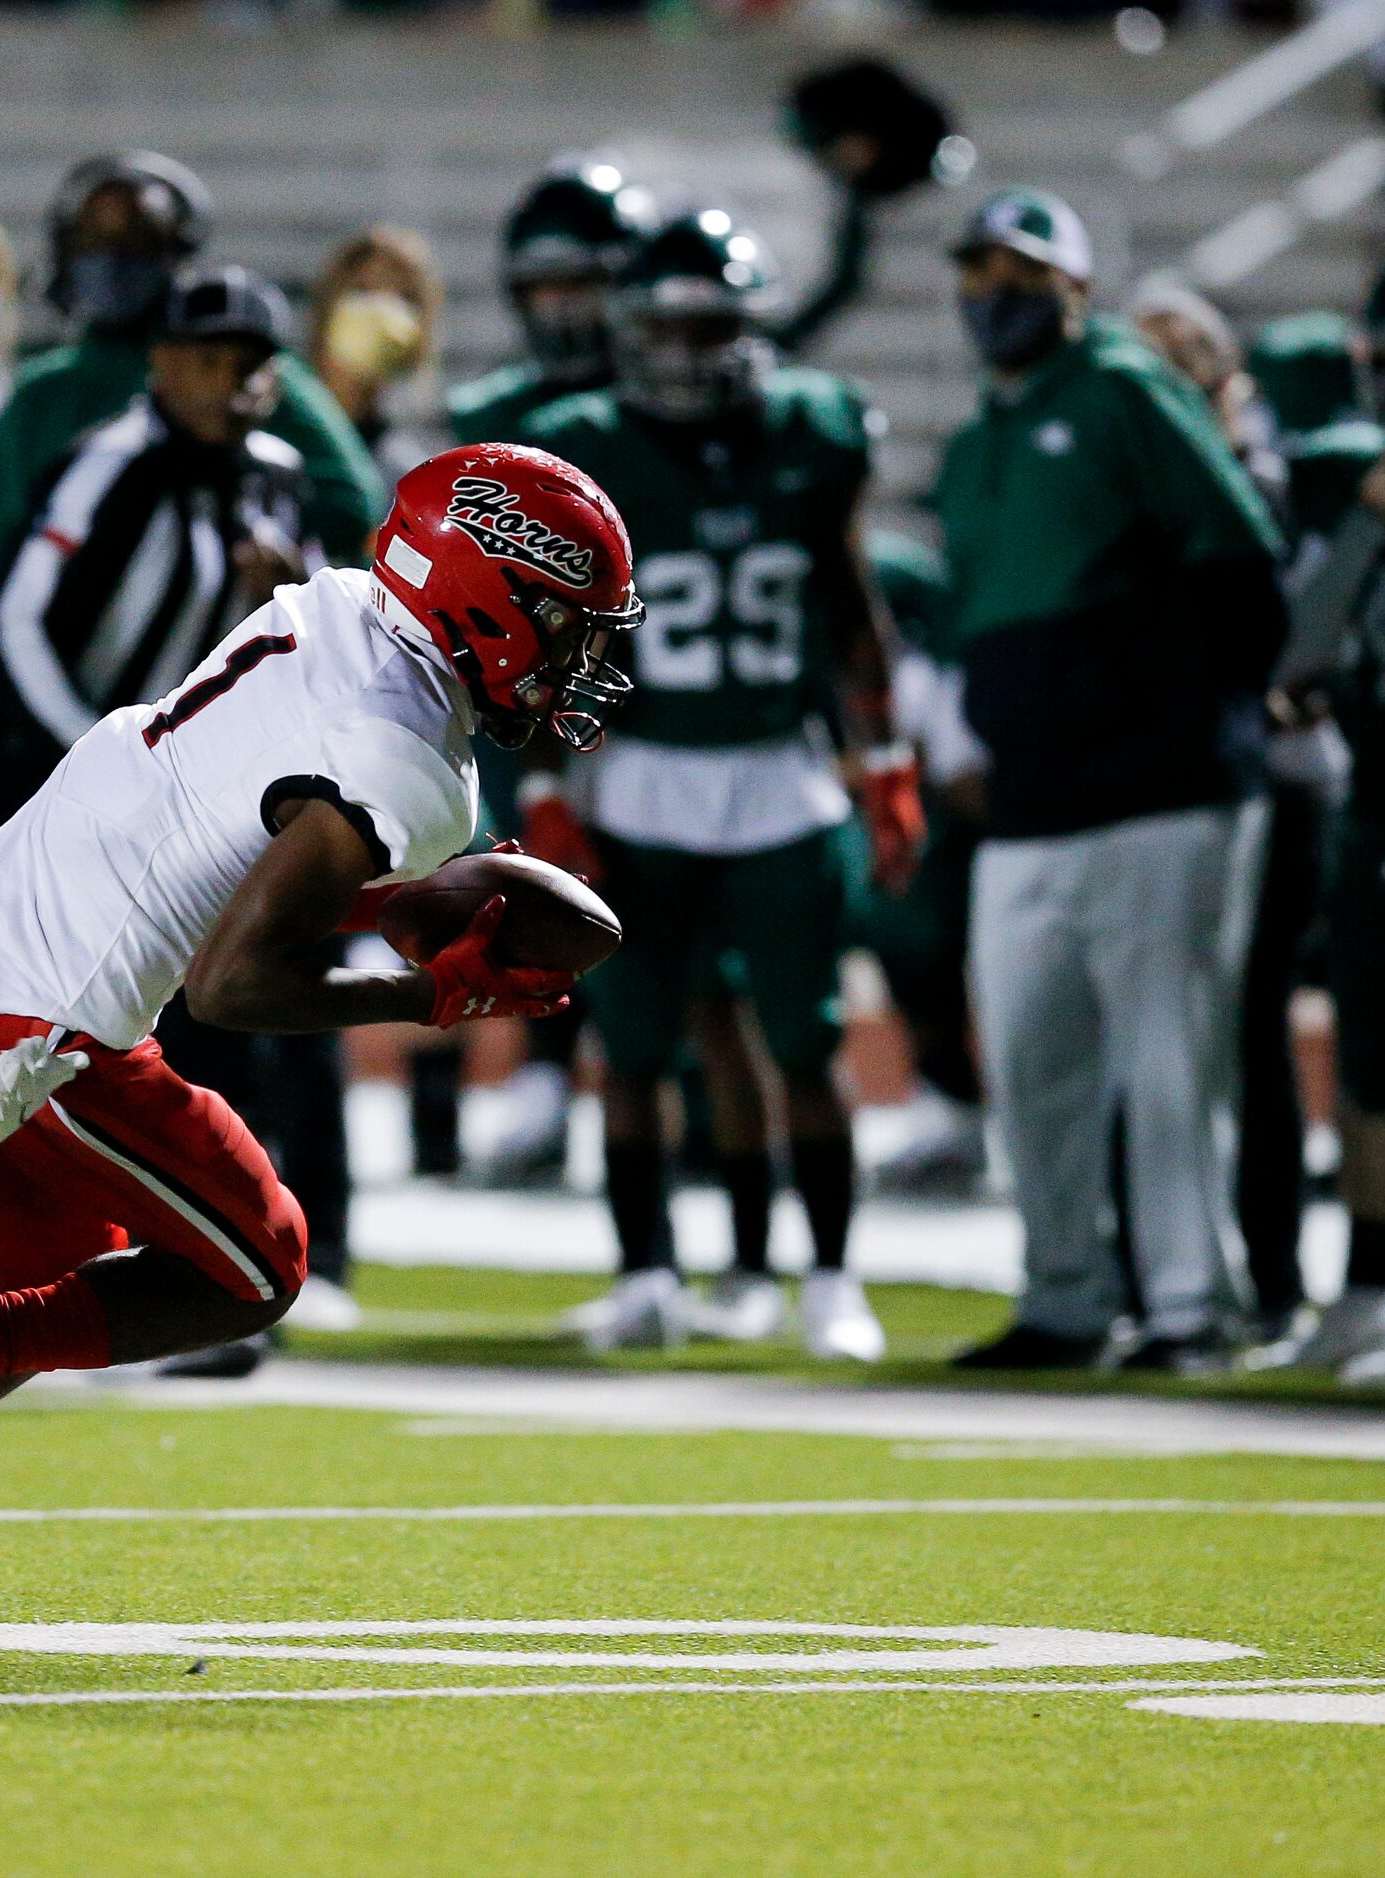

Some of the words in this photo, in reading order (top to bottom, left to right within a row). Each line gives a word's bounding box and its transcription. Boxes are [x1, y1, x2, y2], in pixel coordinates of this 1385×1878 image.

[447, 476, 593, 588] Horns
[633, 545, 812, 690] 29
[142, 633, 297, 749] 1
